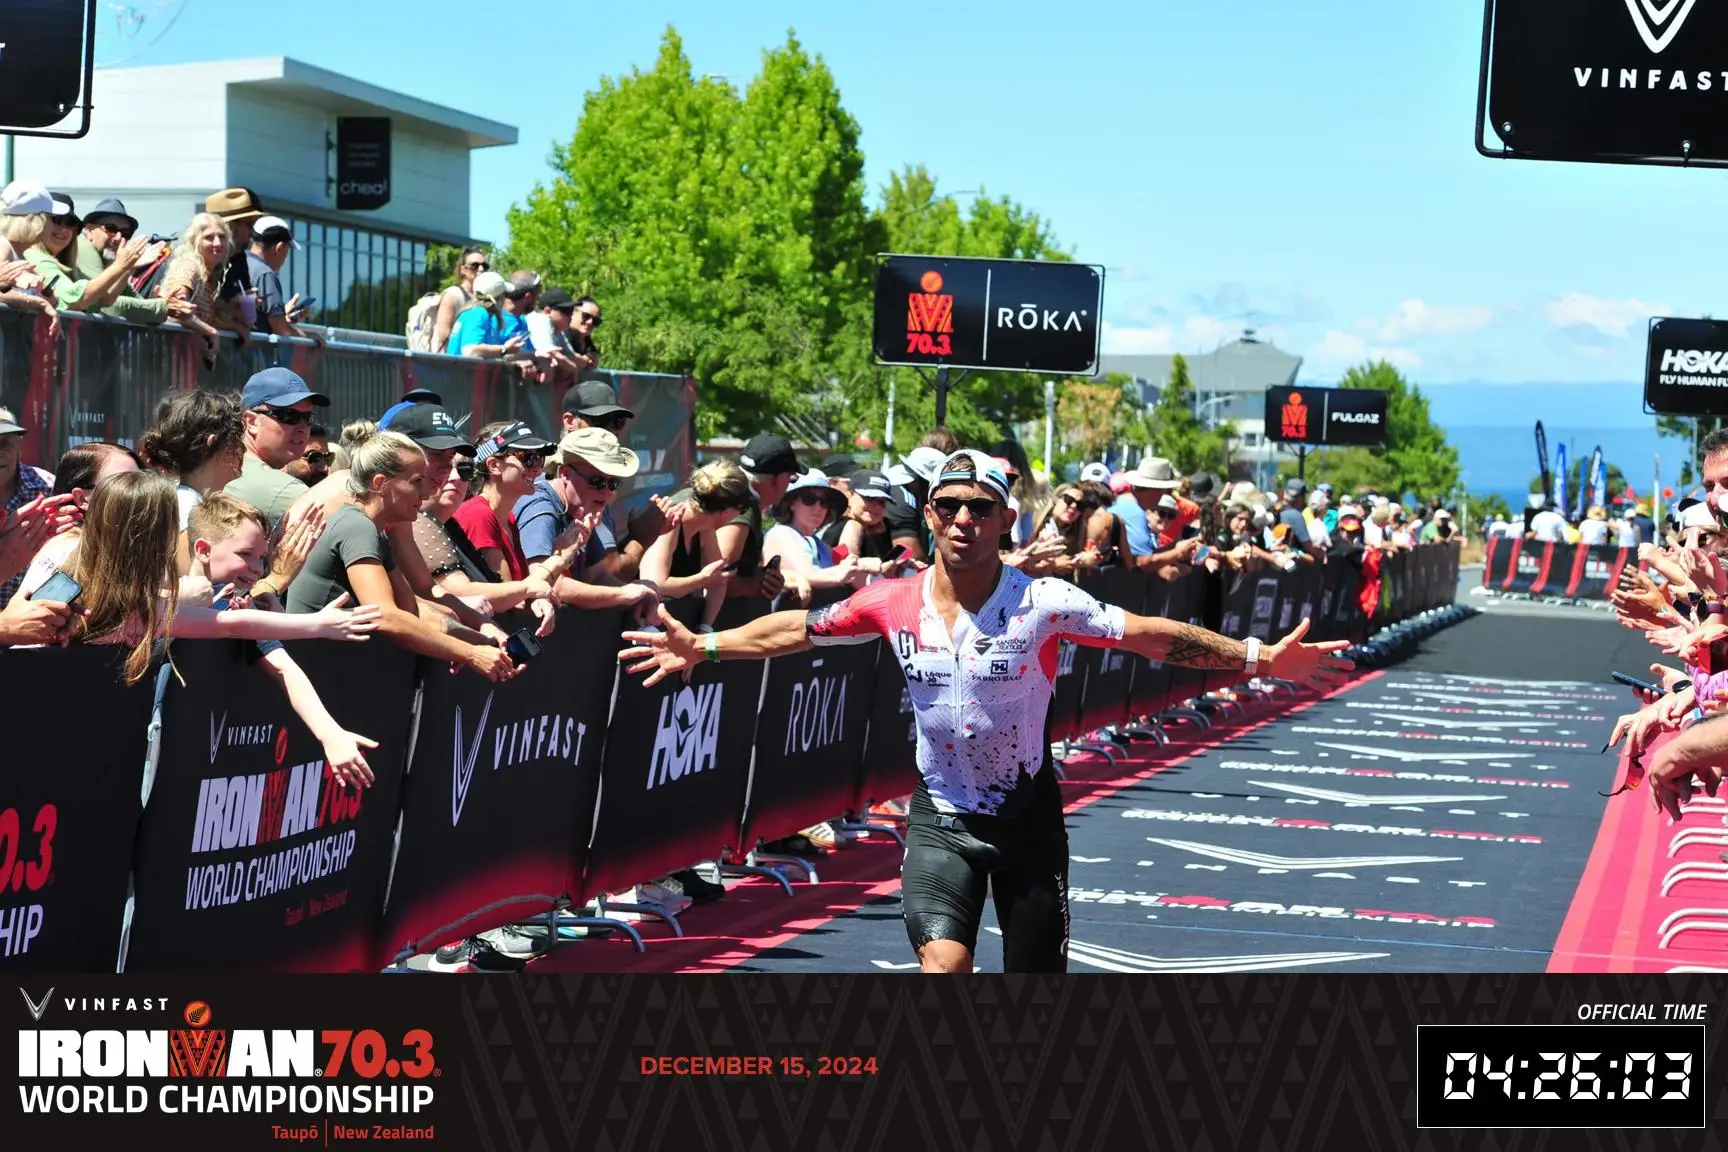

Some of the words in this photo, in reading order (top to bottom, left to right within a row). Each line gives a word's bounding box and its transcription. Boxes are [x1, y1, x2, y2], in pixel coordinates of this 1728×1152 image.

[906, 333, 951, 355] 70.3
[1660, 374, 1676, 385] FLY
[1677, 375, 1716, 387] HUMAN
[1717, 377, 1728, 388] FL
[1331, 411, 1380, 424] FULGAZ
[227, 724, 273, 746] VINFAST
[493, 714, 586, 770] VINFAST
[647, 682, 723, 790] HOKA
[191, 760, 323, 853] IRONMAN
[185, 861, 244, 910] WORLD
[245, 829, 356, 902] CHAMPIONSHIP
